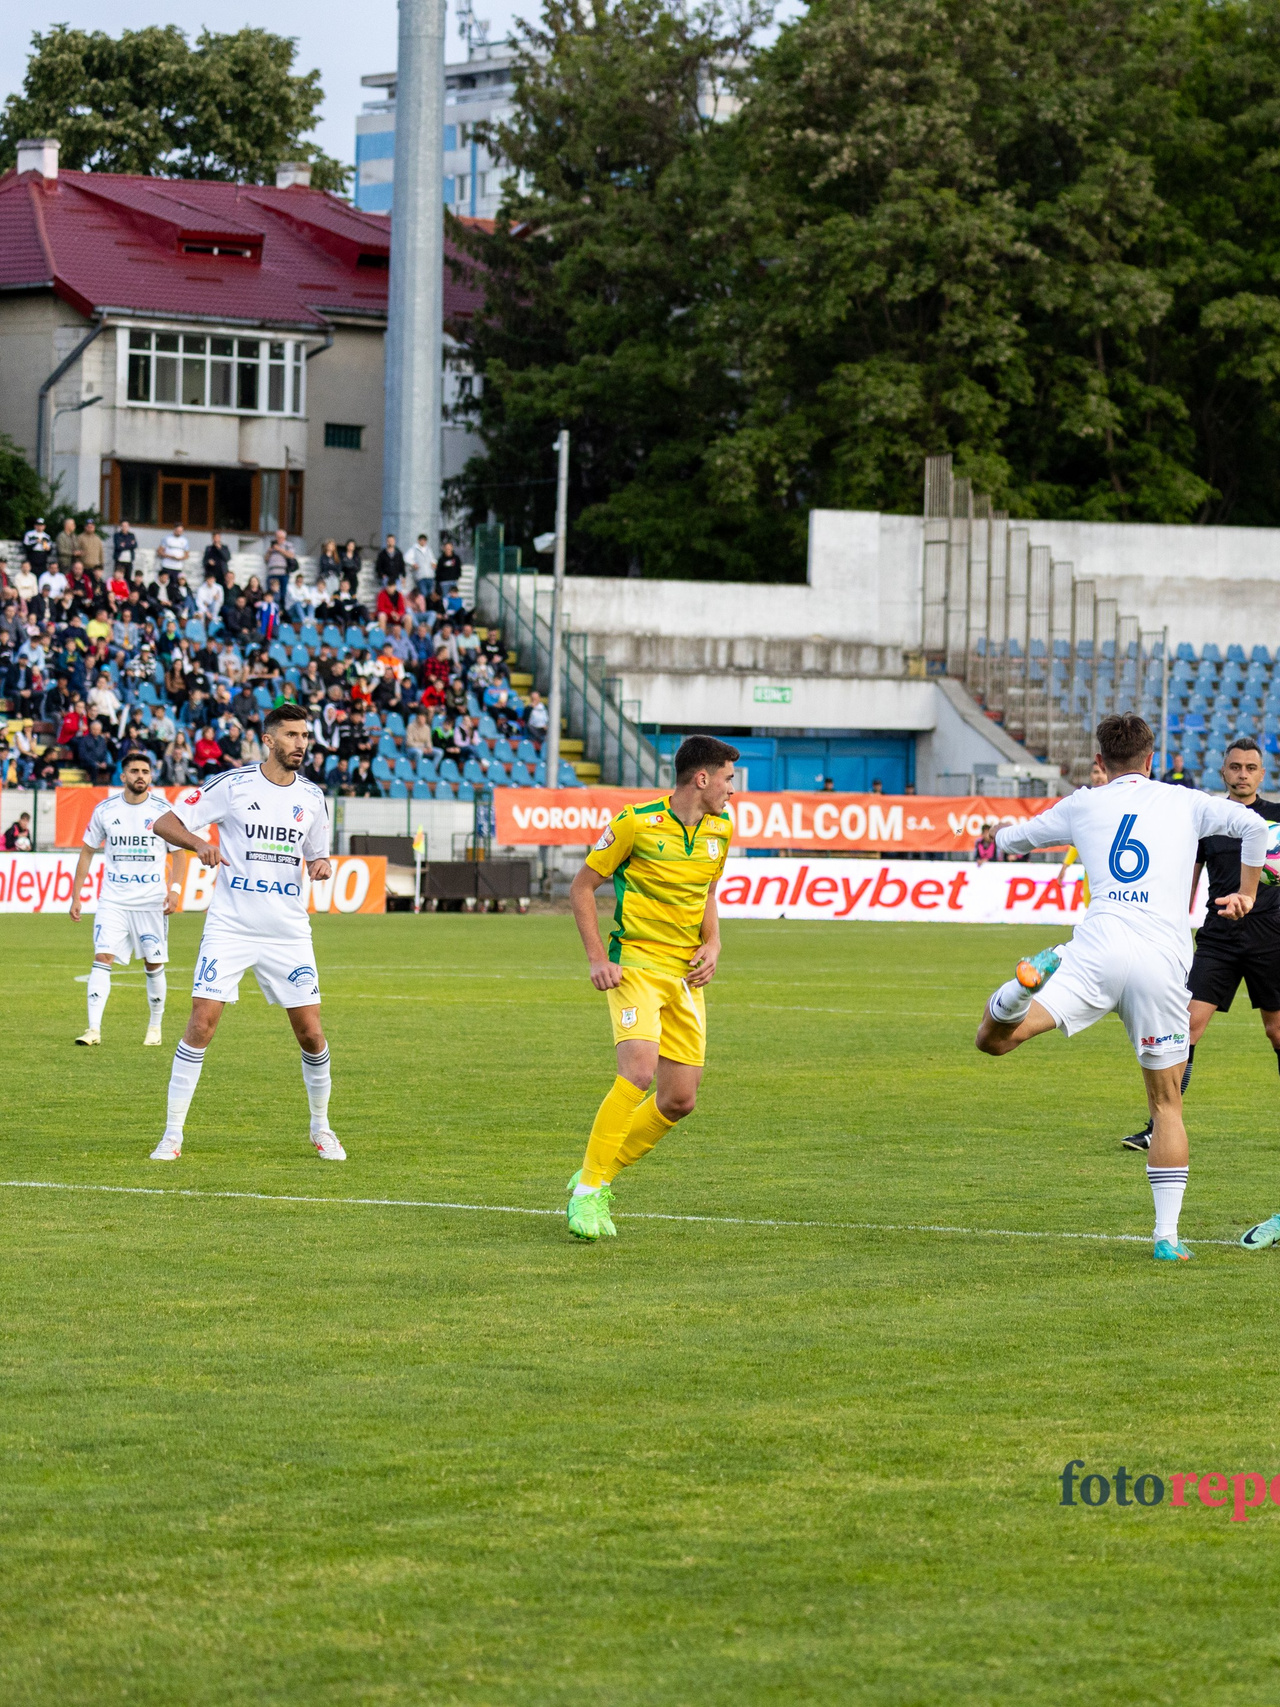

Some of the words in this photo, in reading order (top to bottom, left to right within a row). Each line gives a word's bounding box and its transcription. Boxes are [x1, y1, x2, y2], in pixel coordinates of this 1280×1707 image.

[512, 804, 614, 830] VORONA
[724, 801, 904, 841] DALCOM
[907, 815, 935, 831] S.A.
[110, 835, 156, 847] UNIBET
[245, 823, 304, 844] UNIBET
[1108, 814, 1150, 883] 6
[107, 871, 161, 884] ELSACO
[95, 924, 102, 943] 7
[199, 956, 218, 983] 16
